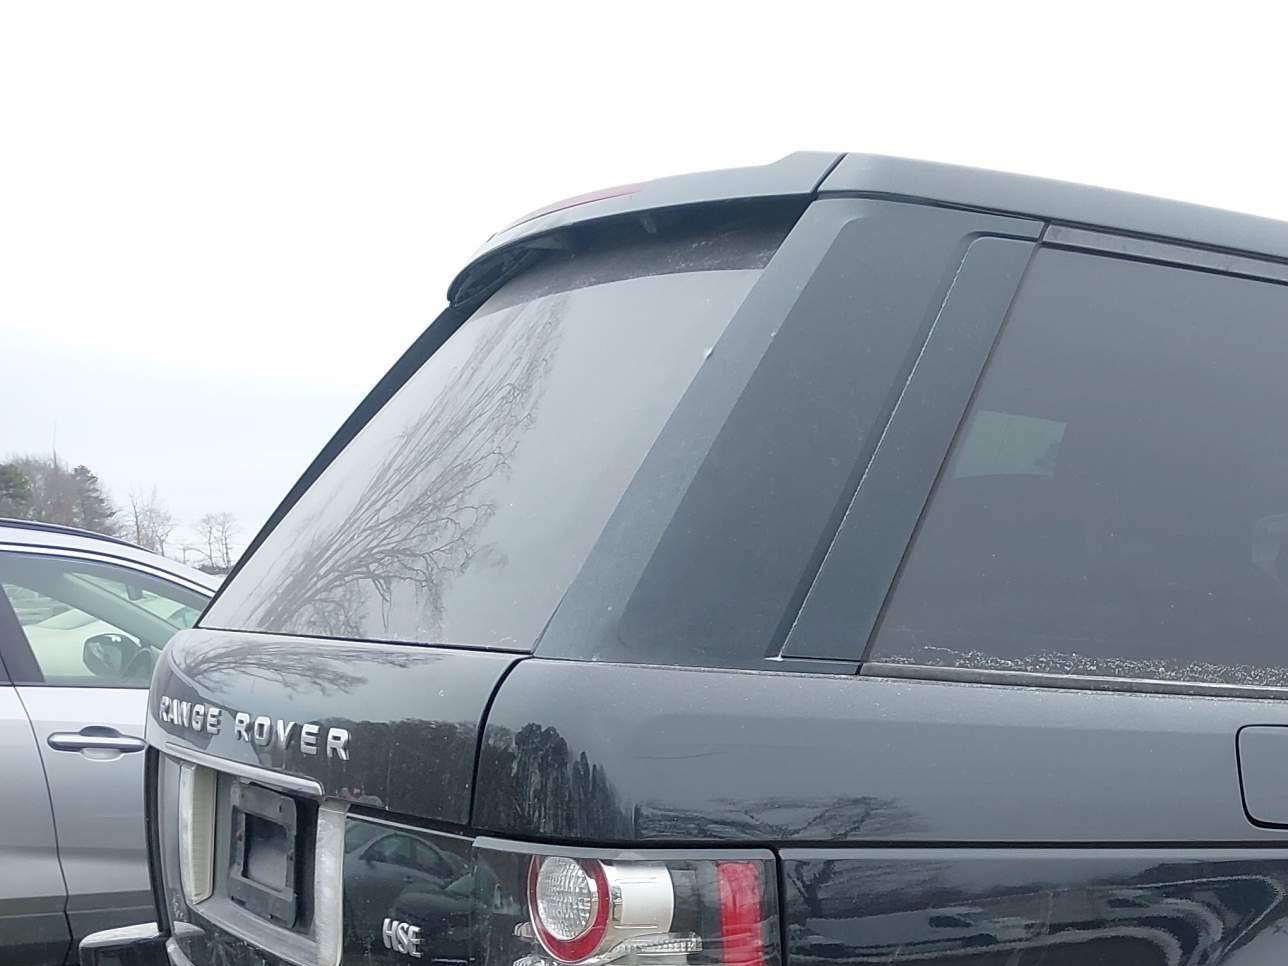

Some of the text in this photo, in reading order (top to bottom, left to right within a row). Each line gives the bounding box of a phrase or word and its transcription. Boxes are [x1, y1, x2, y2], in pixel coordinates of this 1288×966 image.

[159, 695, 351, 761] RANGE ROVER
[383, 917, 424, 958] HSE
